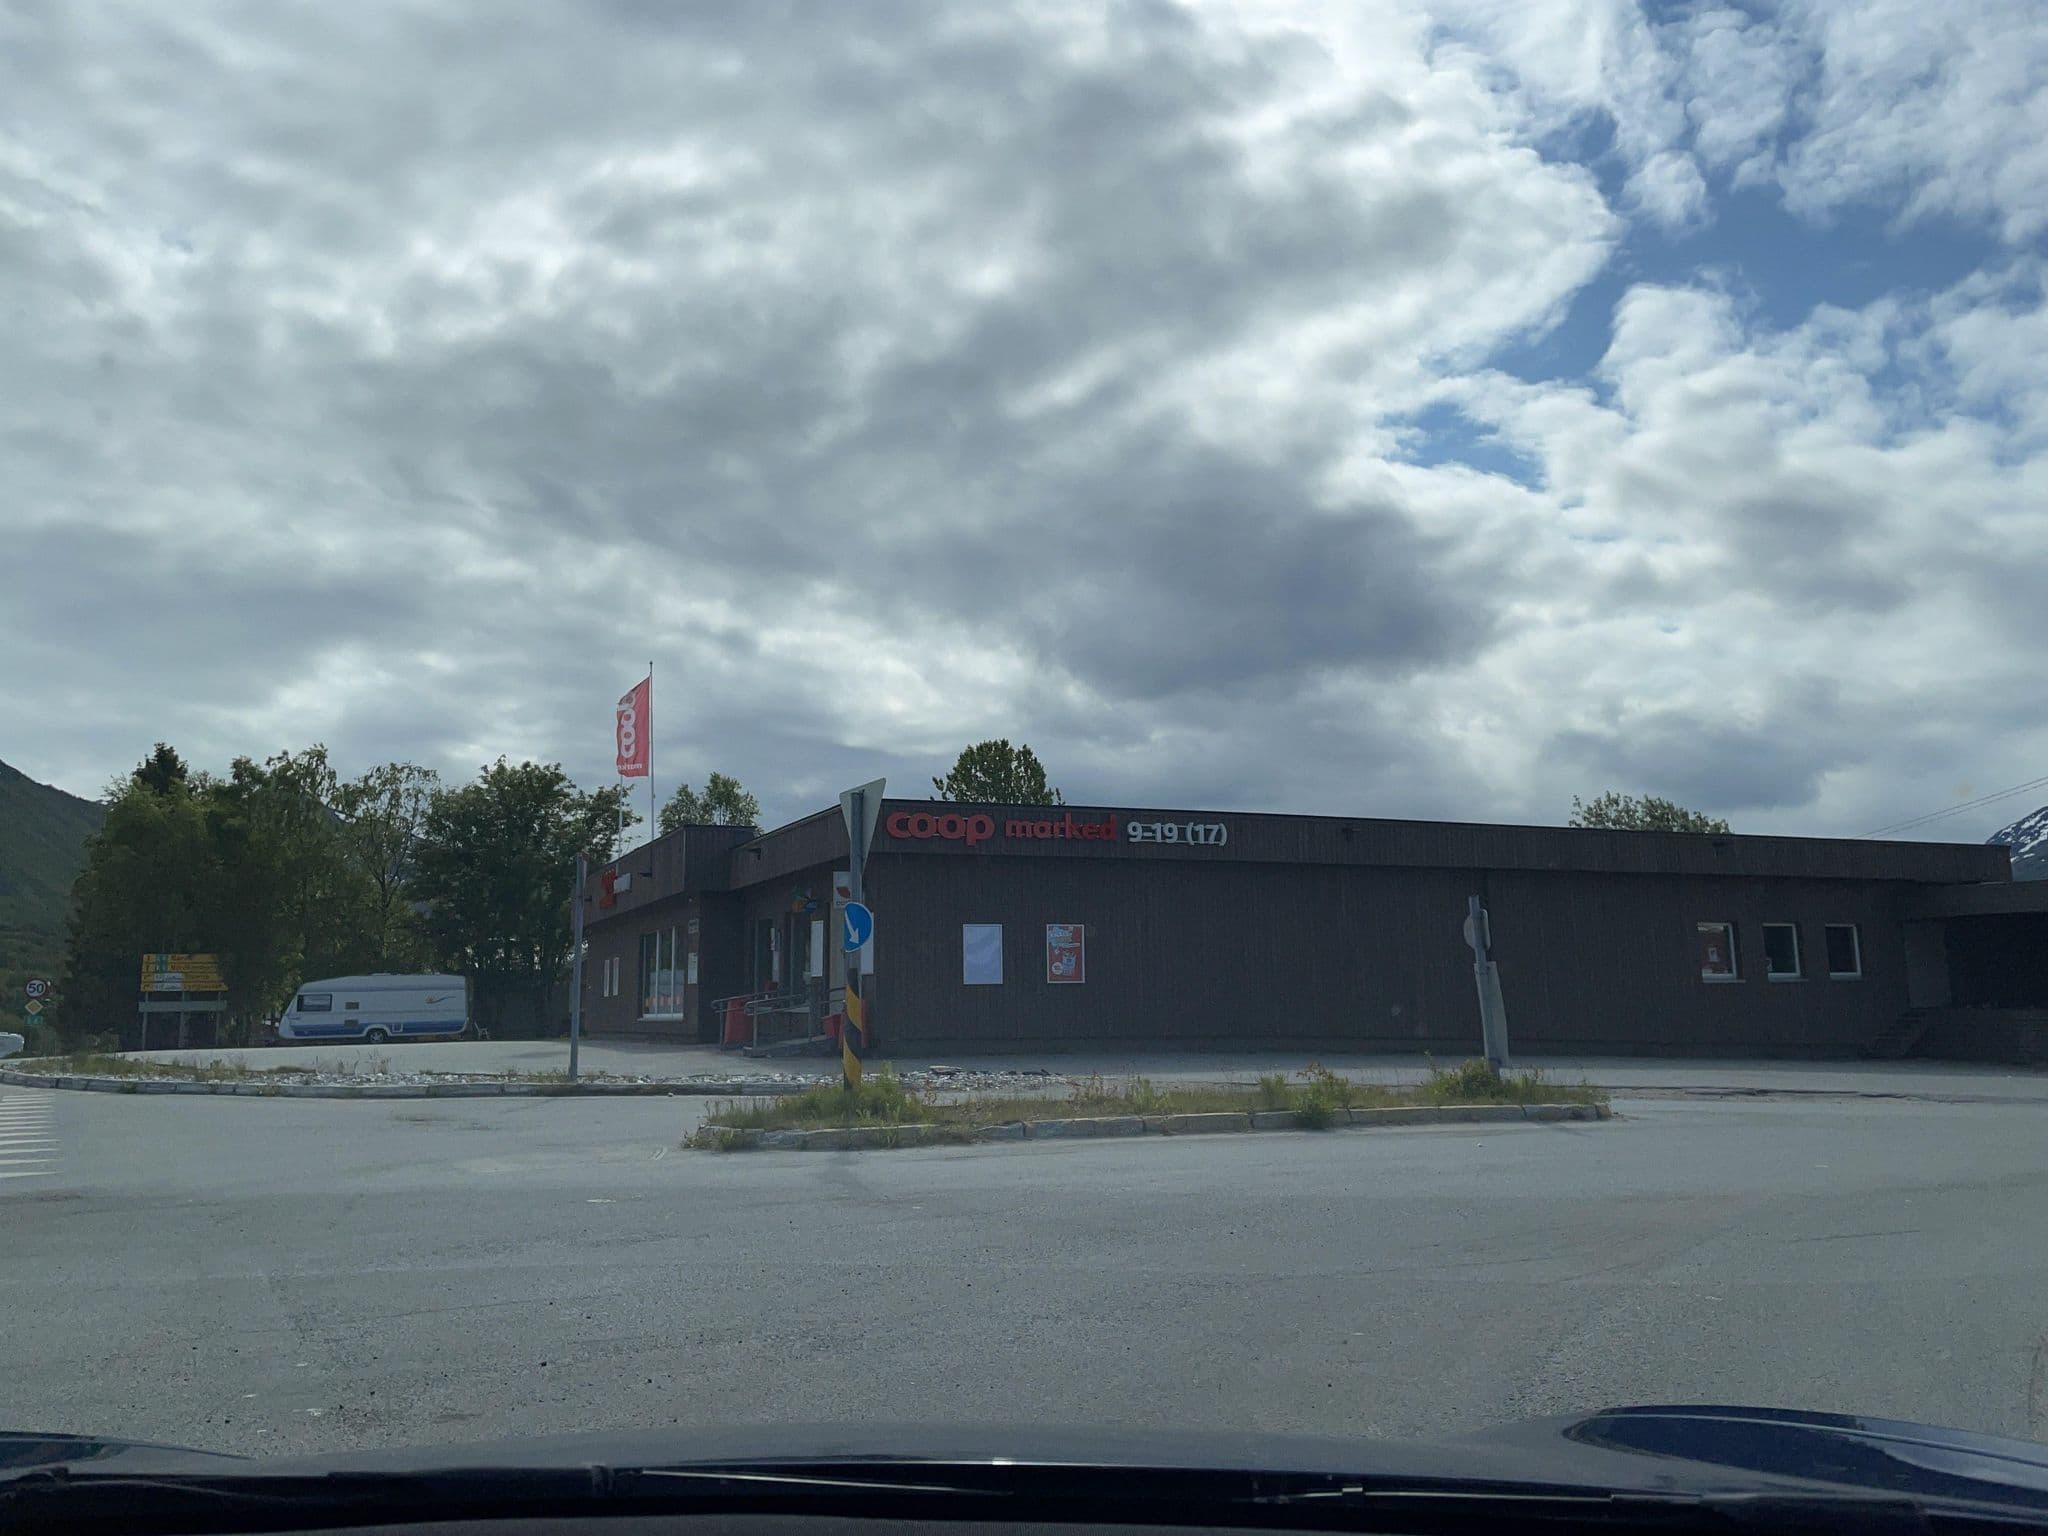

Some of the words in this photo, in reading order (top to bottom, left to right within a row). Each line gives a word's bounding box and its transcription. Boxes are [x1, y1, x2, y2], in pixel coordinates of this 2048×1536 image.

[886, 811, 995, 846] coop
[1005, 812, 1117, 840] marked
[1127, 821, 1178, 844] 9-19
[1186, 821, 1228, 847] (17)
[28, 983, 45, 994] 50
